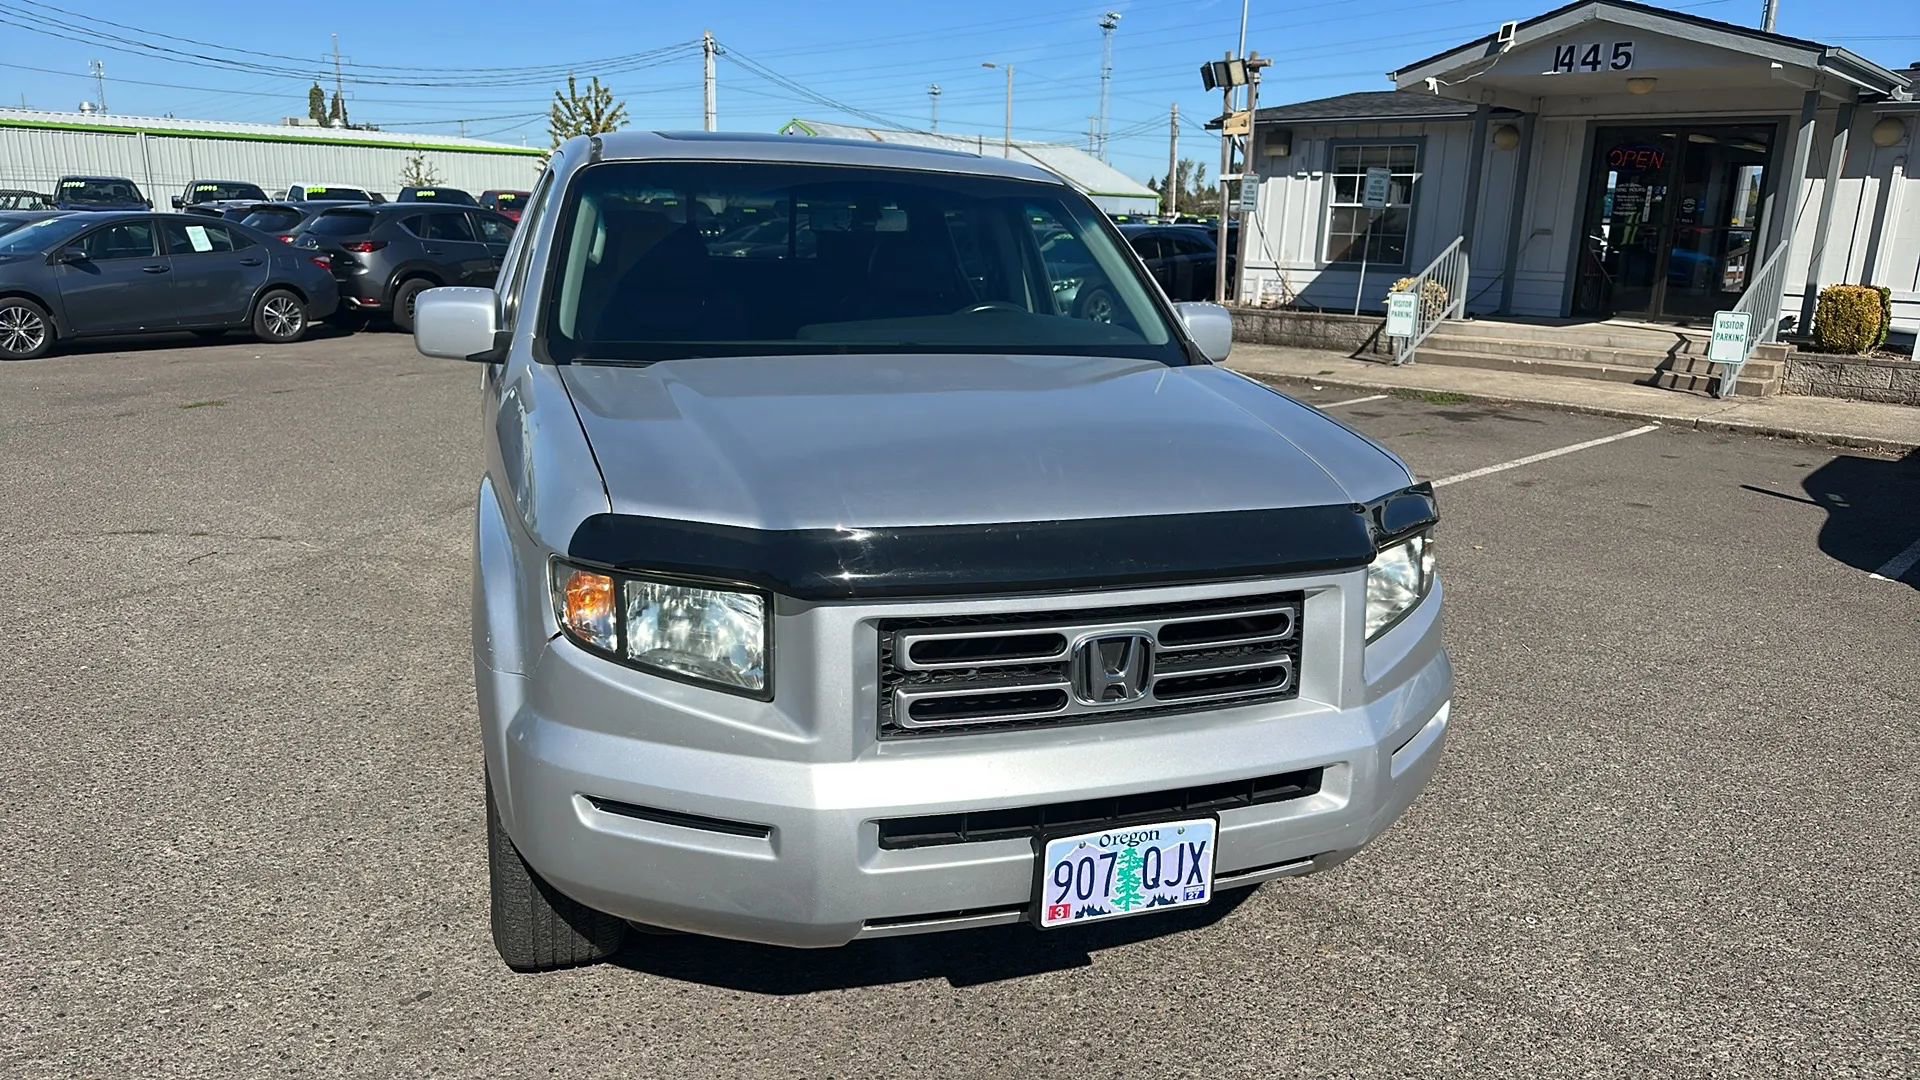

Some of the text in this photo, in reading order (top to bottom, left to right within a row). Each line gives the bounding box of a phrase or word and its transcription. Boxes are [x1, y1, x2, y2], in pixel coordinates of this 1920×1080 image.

[1553, 42, 1633, 72] 1445
[1610, 150, 1665, 169] OPEN
[1394, 300, 1413, 308] VISITOR
[1391, 310, 1413, 318] PARKING
[1720, 320, 1745, 330] VISITOR
[1715, 332, 1744, 342] PARKING
[1099, 829, 1160, 848] Oregon
[1054, 840, 1206, 904] 907 QJX
[1187, 891, 1200, 899] 27
[1054, 905, 1065, 919] 3
